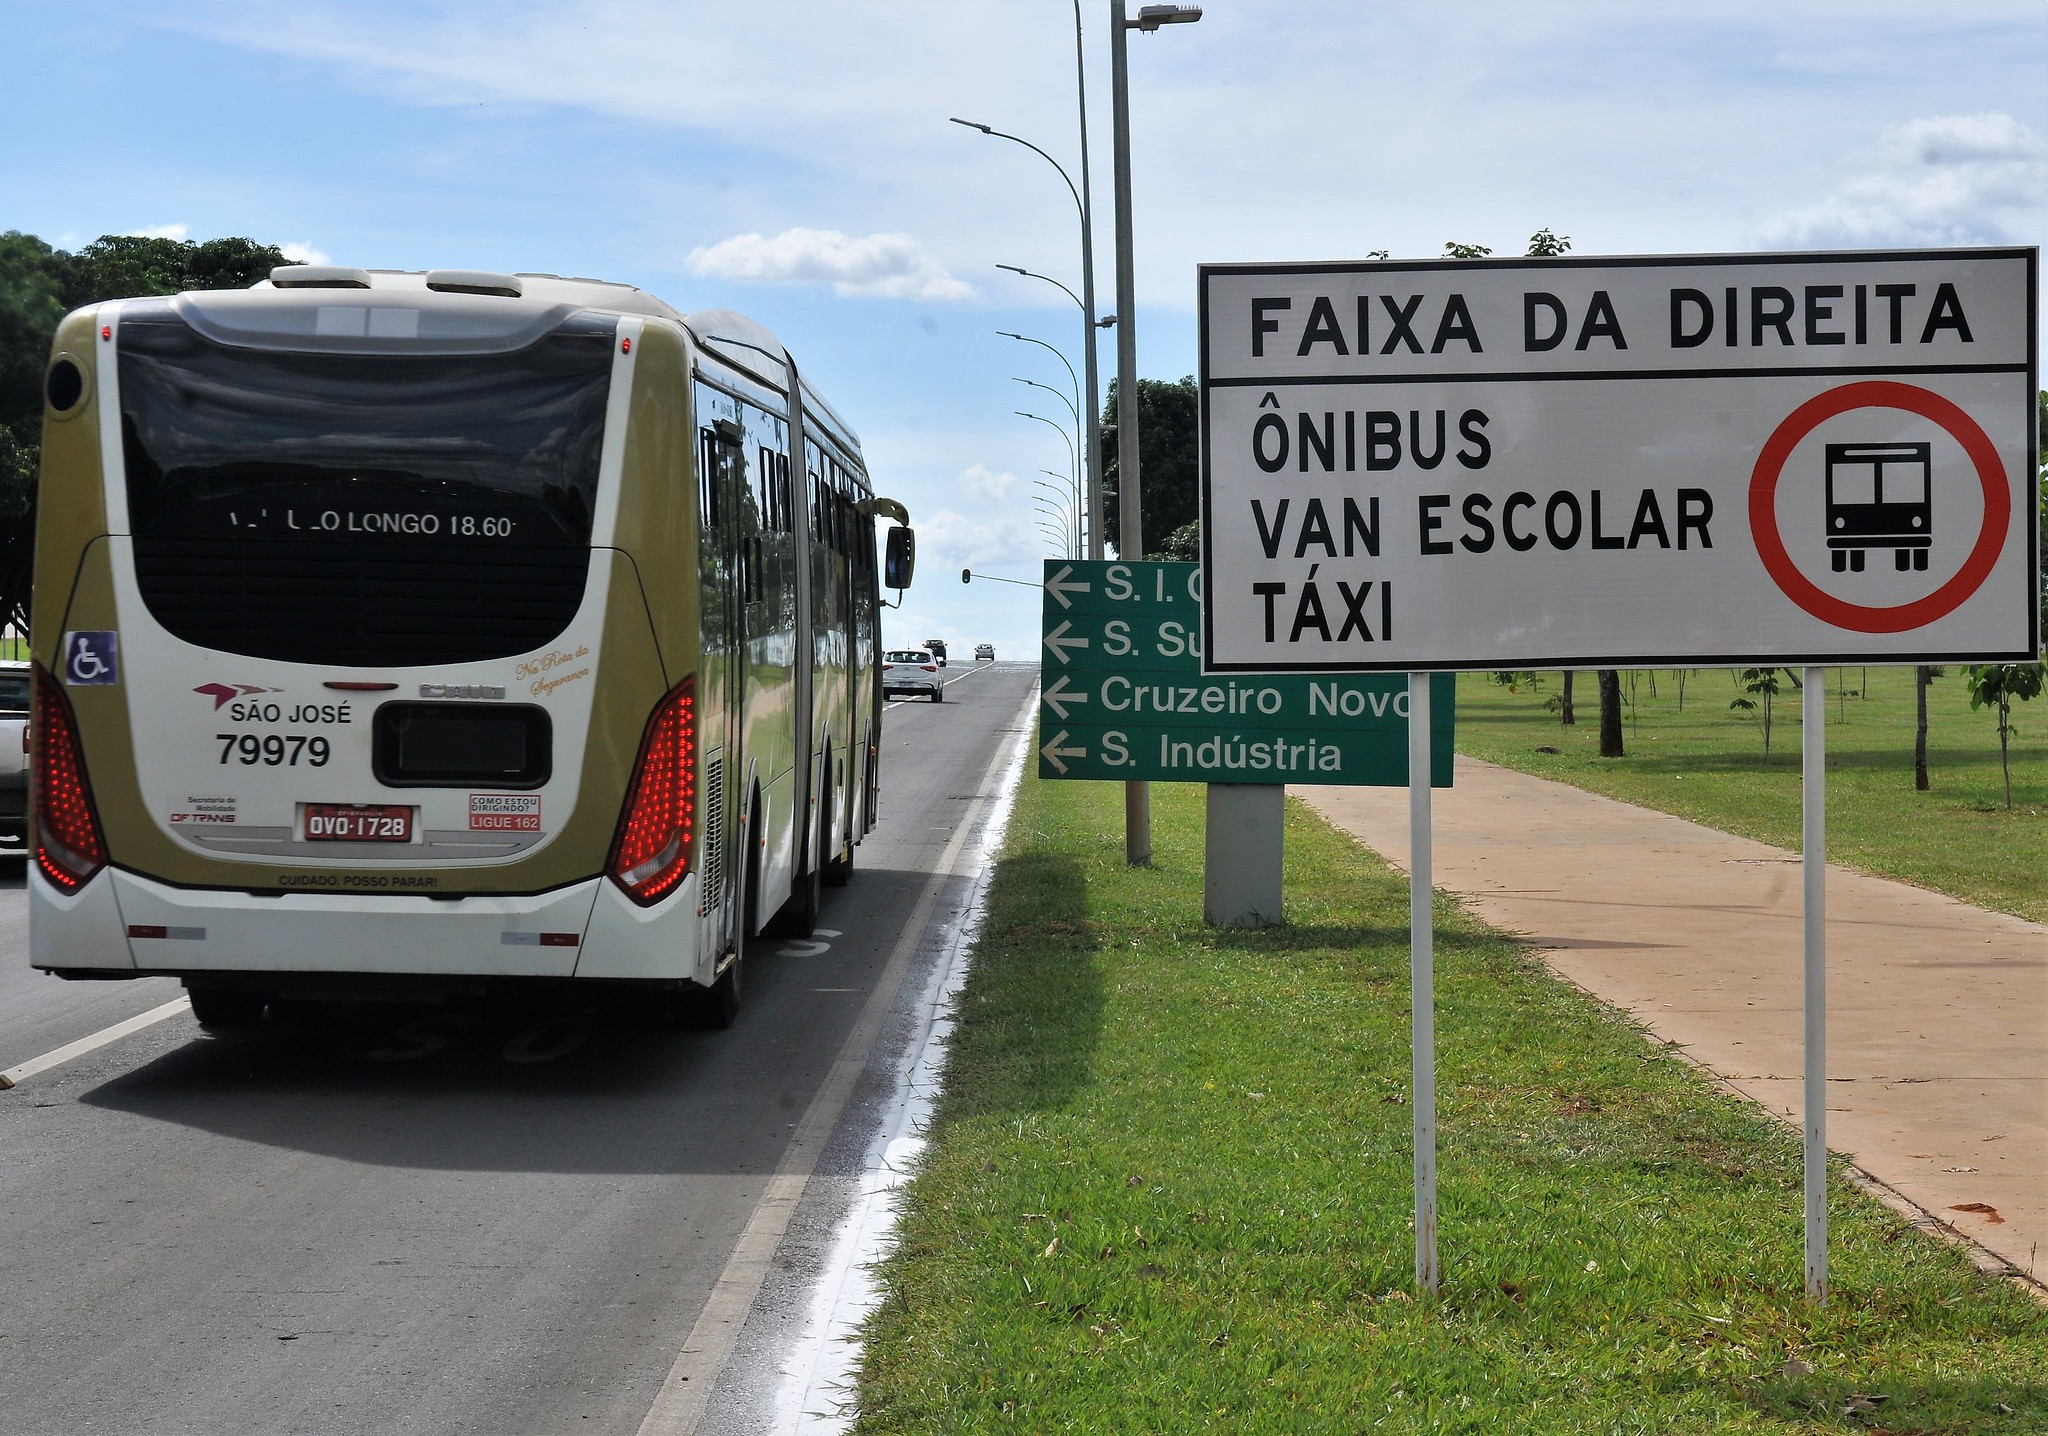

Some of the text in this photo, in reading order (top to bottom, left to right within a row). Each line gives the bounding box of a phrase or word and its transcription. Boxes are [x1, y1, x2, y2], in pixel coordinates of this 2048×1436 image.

[1251, 282, 1974, 358] FAIXA DA DIREITA
[1251, 391, 1492, 473] ÔNIBUS
[1251, 487, 1714, 561] VAN ESCOLAR
[1104, 564, 1141, 602] S.
[1156, 568, 1173, 603] I.
[1252, 563, 1393, 643] TÁXI
[1103, 620, 1201, 658] S. Su
[231, 699, 352, 724] SÃO JOSÉ
[1100, 675, 1409, 717] Cruzeiro Novo
[216, 734, 330, 768] 79979
[1100, 730, 1342, 771] S. Indústria
[471, 804, 529, 812] DIRIGINDO?
[472, 797, 502, 805] COMO
[471, 817, 539, 828] LIGUE 162
[344, 876, 389, 887] POSSO
[393, 877, 438, 887] PARAR!
